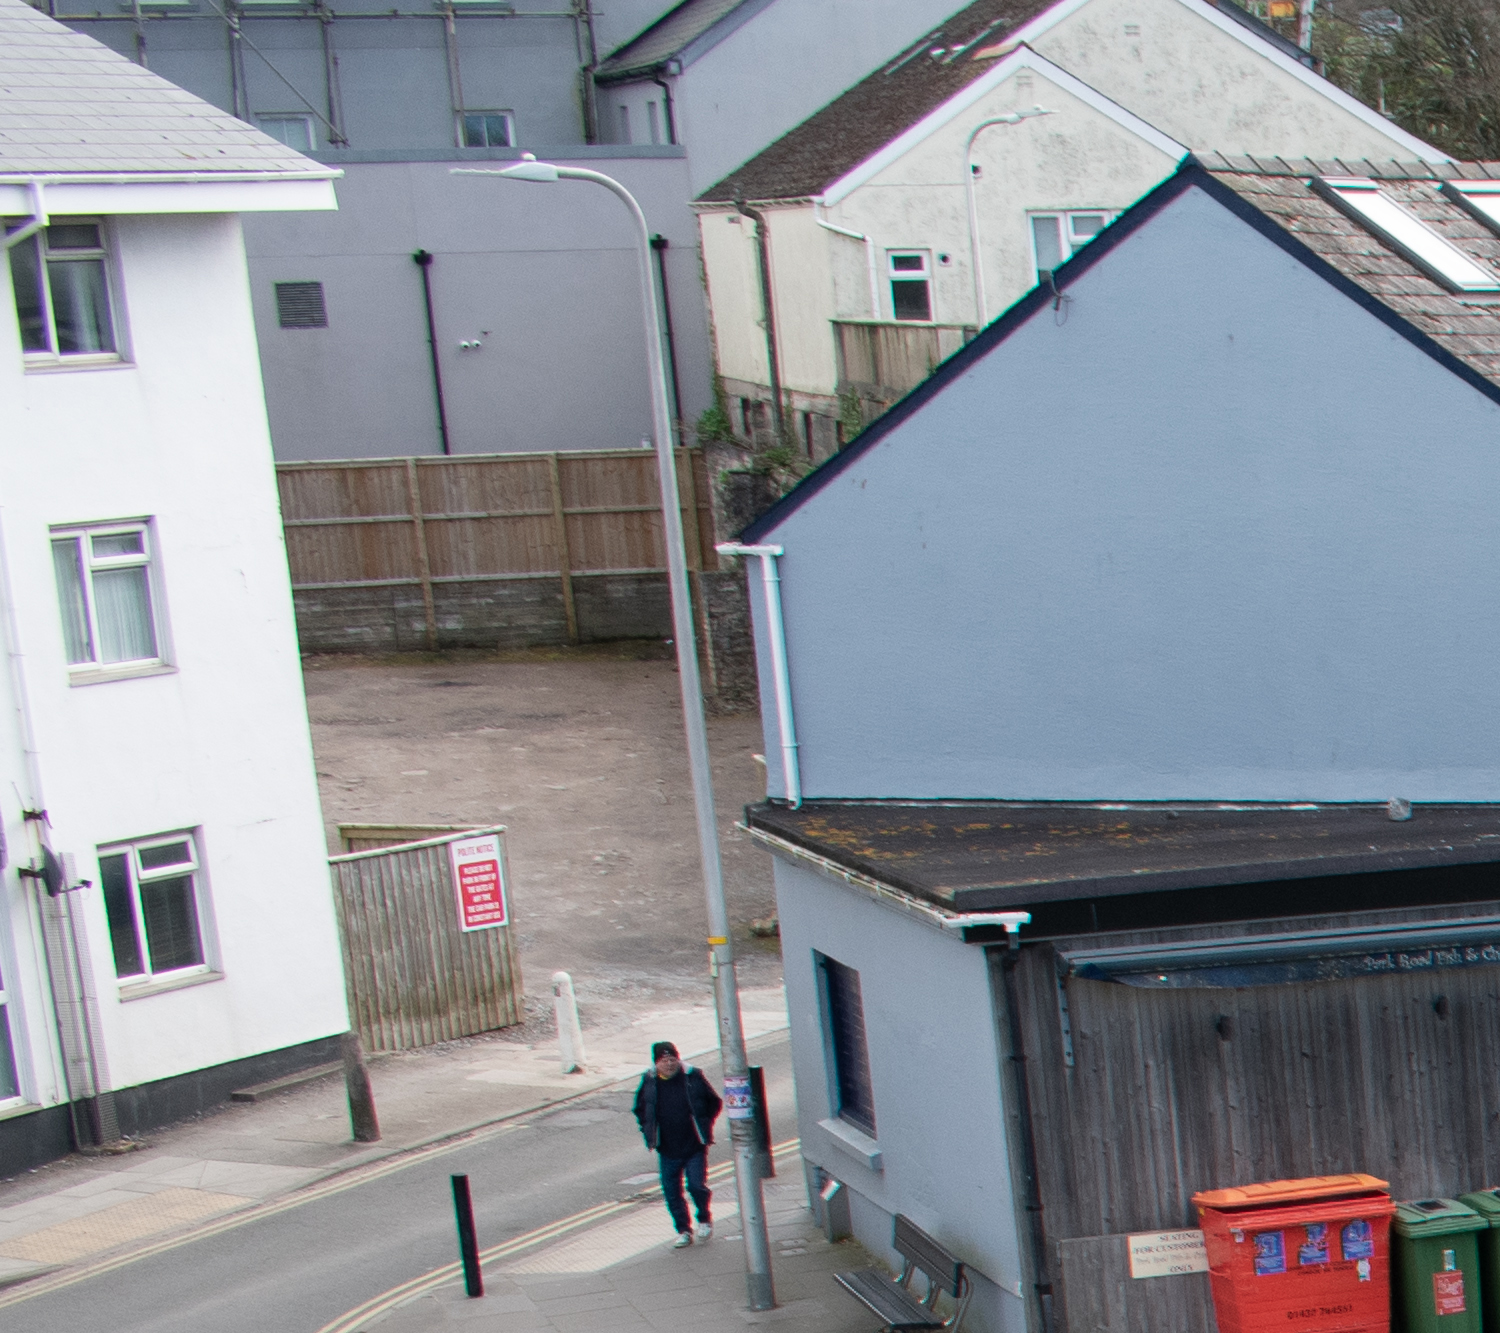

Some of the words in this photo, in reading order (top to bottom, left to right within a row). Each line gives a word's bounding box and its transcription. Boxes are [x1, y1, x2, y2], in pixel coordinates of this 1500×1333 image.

[1398, 950, 1433, 969] Road
[1436, 947, 1463, 966] Fish
[1464, 946, 1479, 962] &
[1158, 1232, 1199, 1241] SEATING
[1133, 1246, 1154, 1255] FOR
[1168, 1264, 1194, 1273] ONLY
